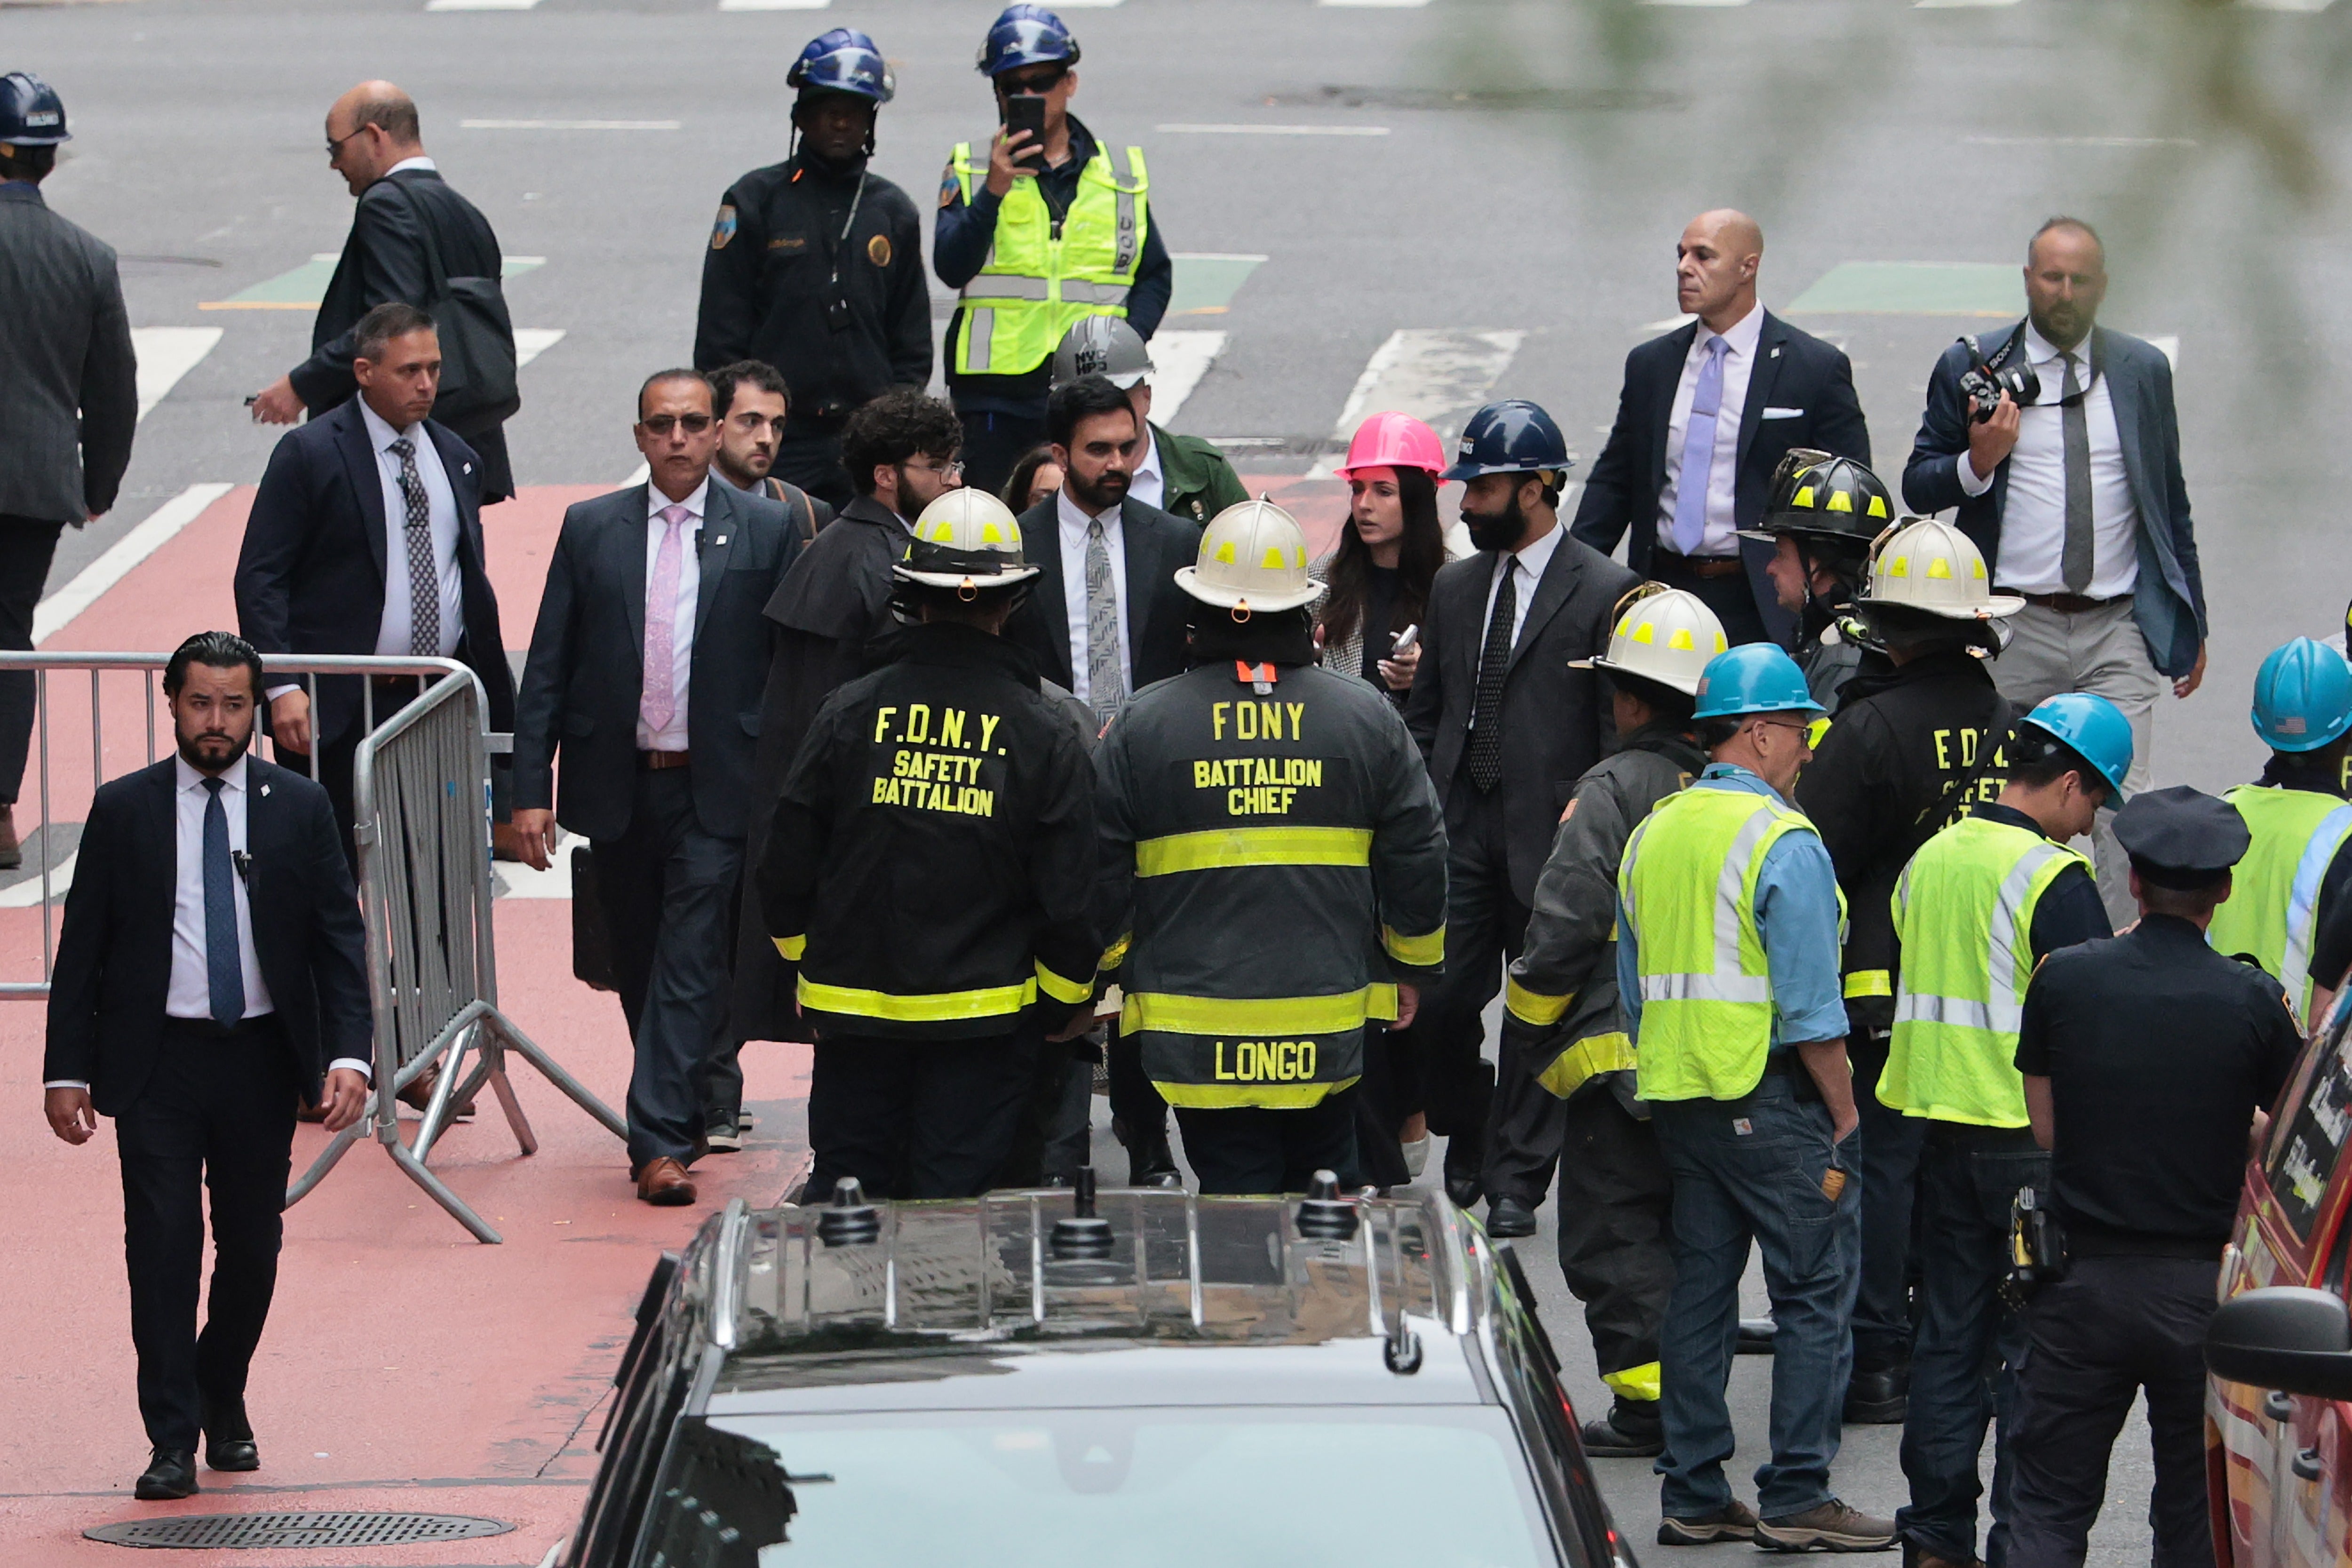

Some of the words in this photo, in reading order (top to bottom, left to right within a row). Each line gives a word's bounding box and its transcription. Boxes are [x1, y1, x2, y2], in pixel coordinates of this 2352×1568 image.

[1075, 349, 1107, 364] NYC
[1076, 361, 1108, 376] HPD
[1213, 700, 1305, 740] FDNY
[893, 750, 982, 785] SAFETY
[1193, 758, 1322, 788] BATTALION
[872, 777, 993, 817] BATTALION
[1228, 787, 1297, 816] CHIEF
[1215, 1041, 1317, 1081] LONGO
